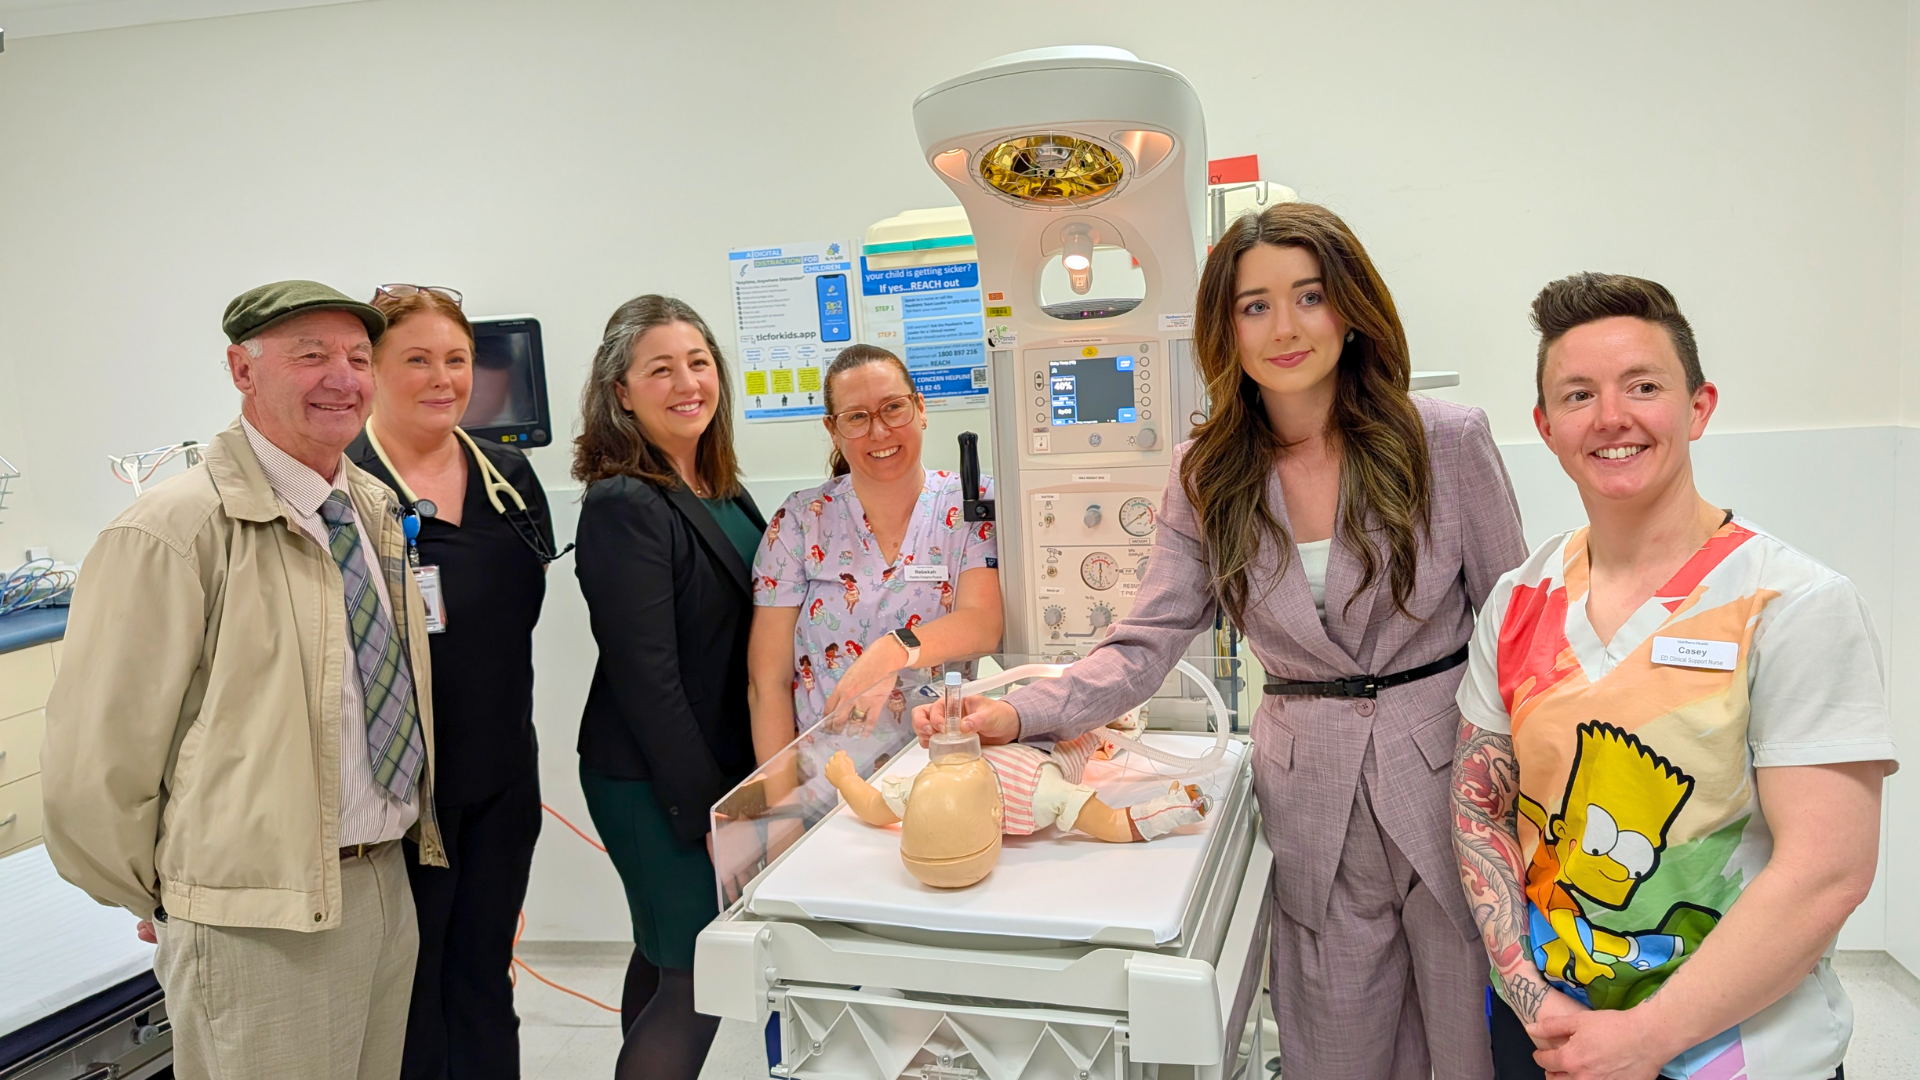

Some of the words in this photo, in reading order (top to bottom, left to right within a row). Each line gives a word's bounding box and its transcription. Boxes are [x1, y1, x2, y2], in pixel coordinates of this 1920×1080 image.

[1208, 175, 1222, 184] CY
[755, 257, 801, 267] DISTRACTION
[804, 264, 840, 272] CHILDREN
[866, 273, 883, 282] your
[885, 270, 904, 279] child
[914, 267, 942, 278] getting
[944, 264, 972, 274] sicker?
[880, 284, 886, 293] If
[756, 331, 816, 341] tlcforkids.app
[1054, 382, 1073, 390] 40%
[1678, 646, 1707, 657] Casey
[1688, 657, 1707, 665] Support
